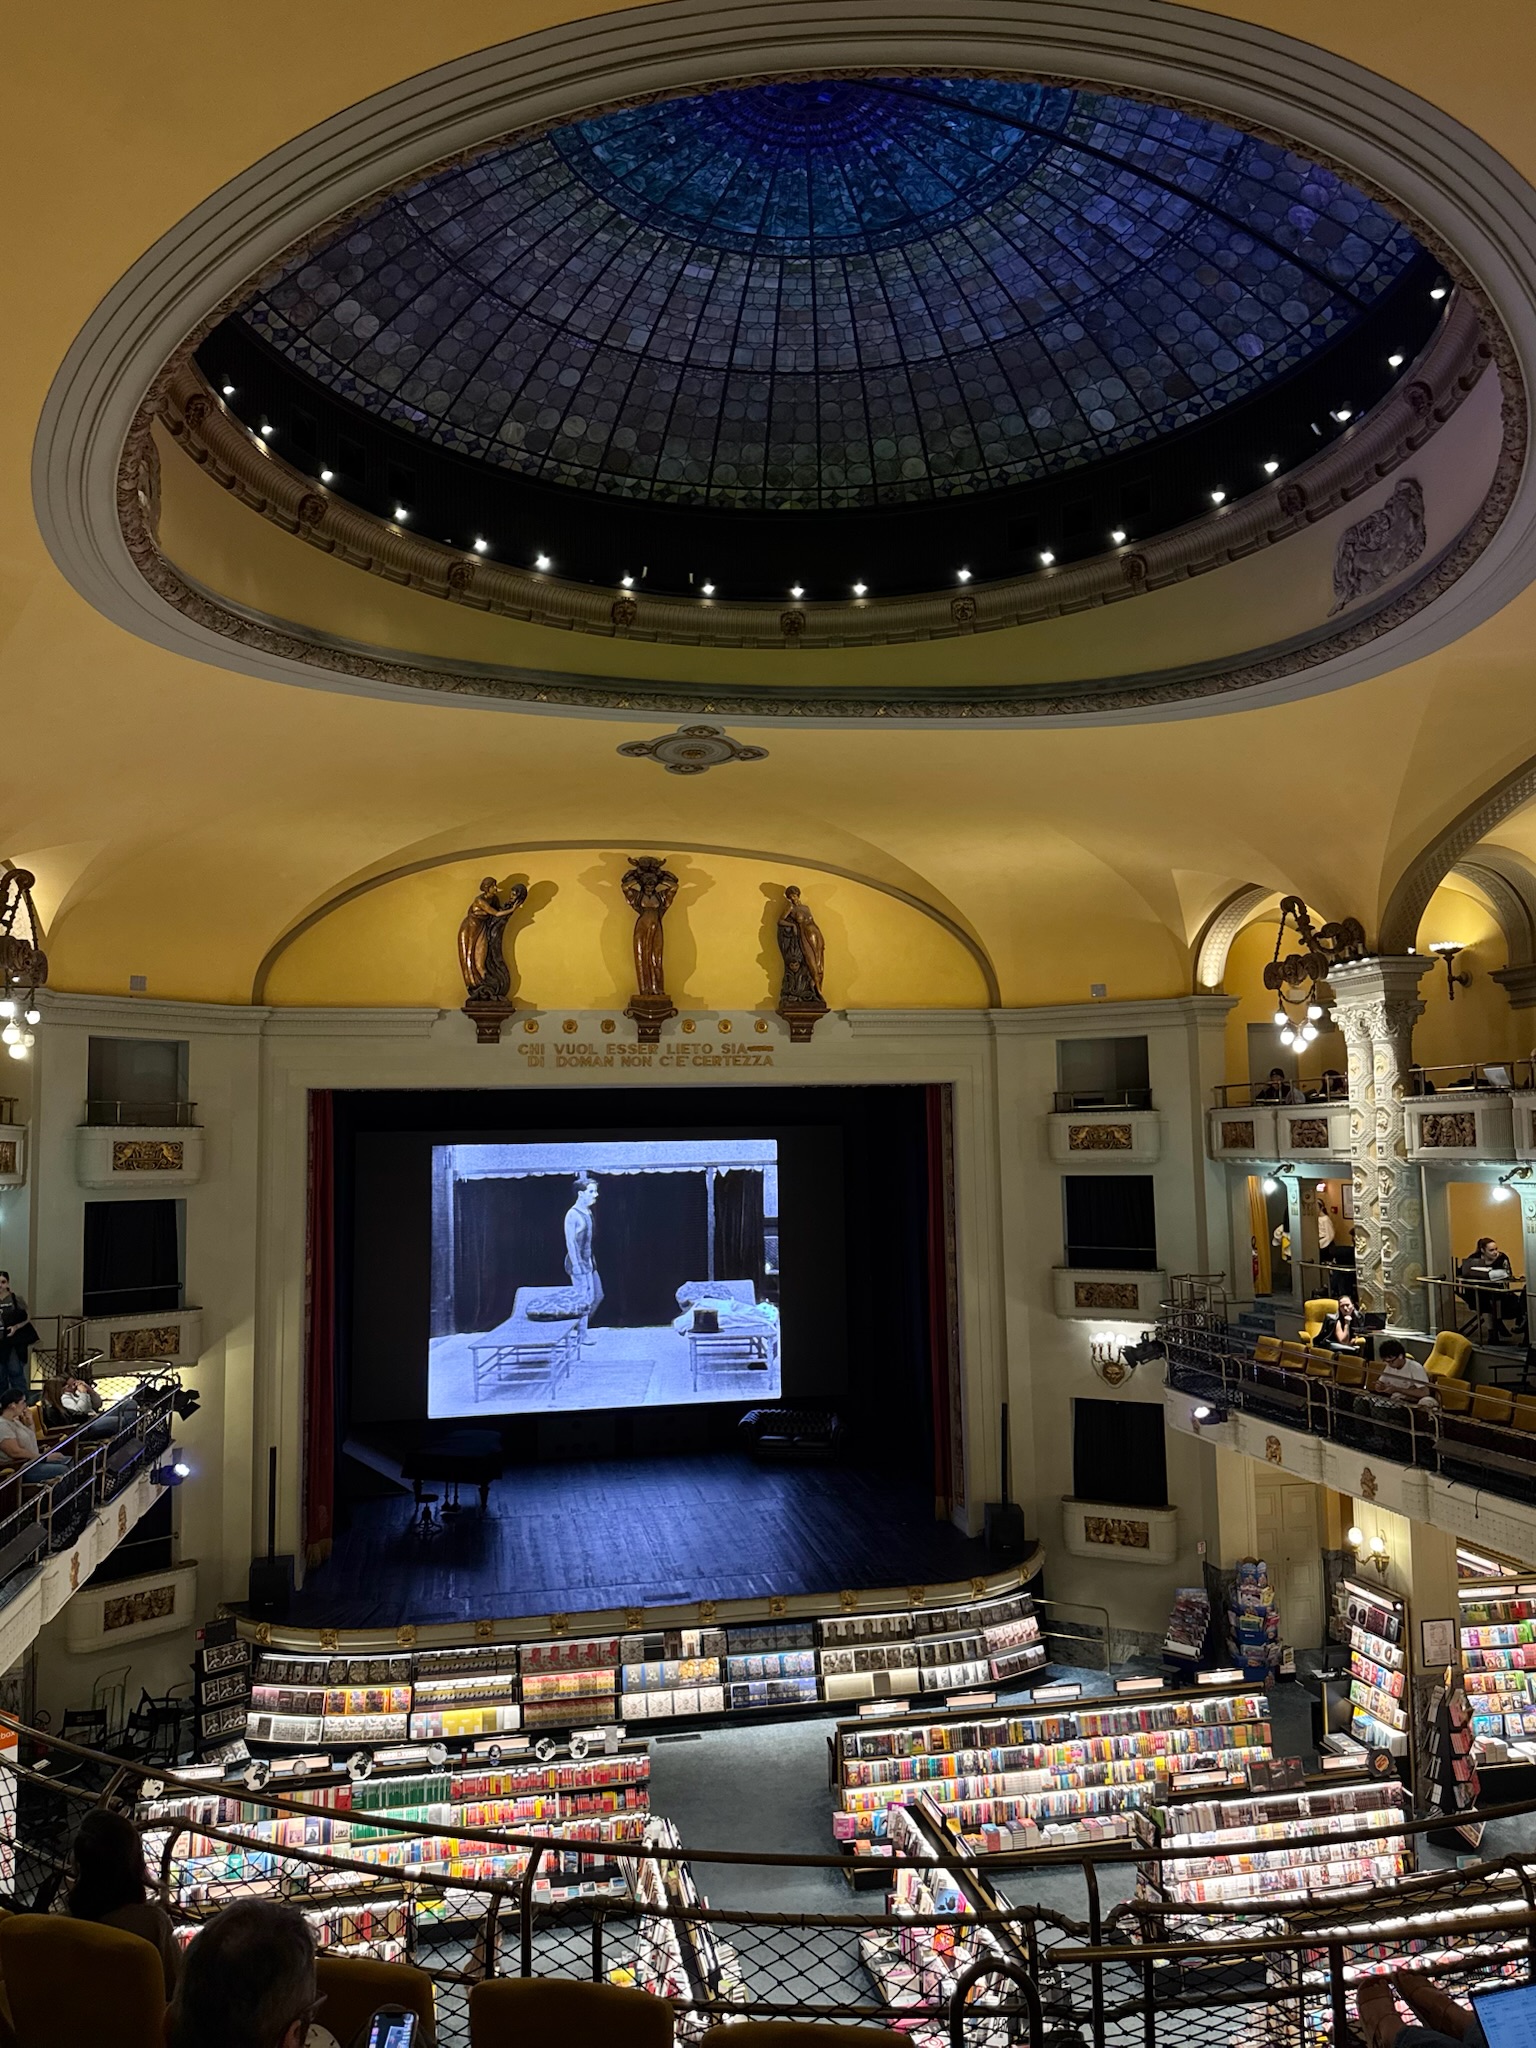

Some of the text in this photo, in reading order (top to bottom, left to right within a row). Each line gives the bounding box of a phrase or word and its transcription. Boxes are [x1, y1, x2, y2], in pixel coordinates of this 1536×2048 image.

[517, 1043, 748, 1055] CHI VUOL ESSER LIETO SIA
[527, 1055, 545, 1067] DI
[555, 1055, 614, 1067] DOMAN
[620, 1055, 652, 1067] NON
[692, 1055, 774, 1066] CERTEZZA
